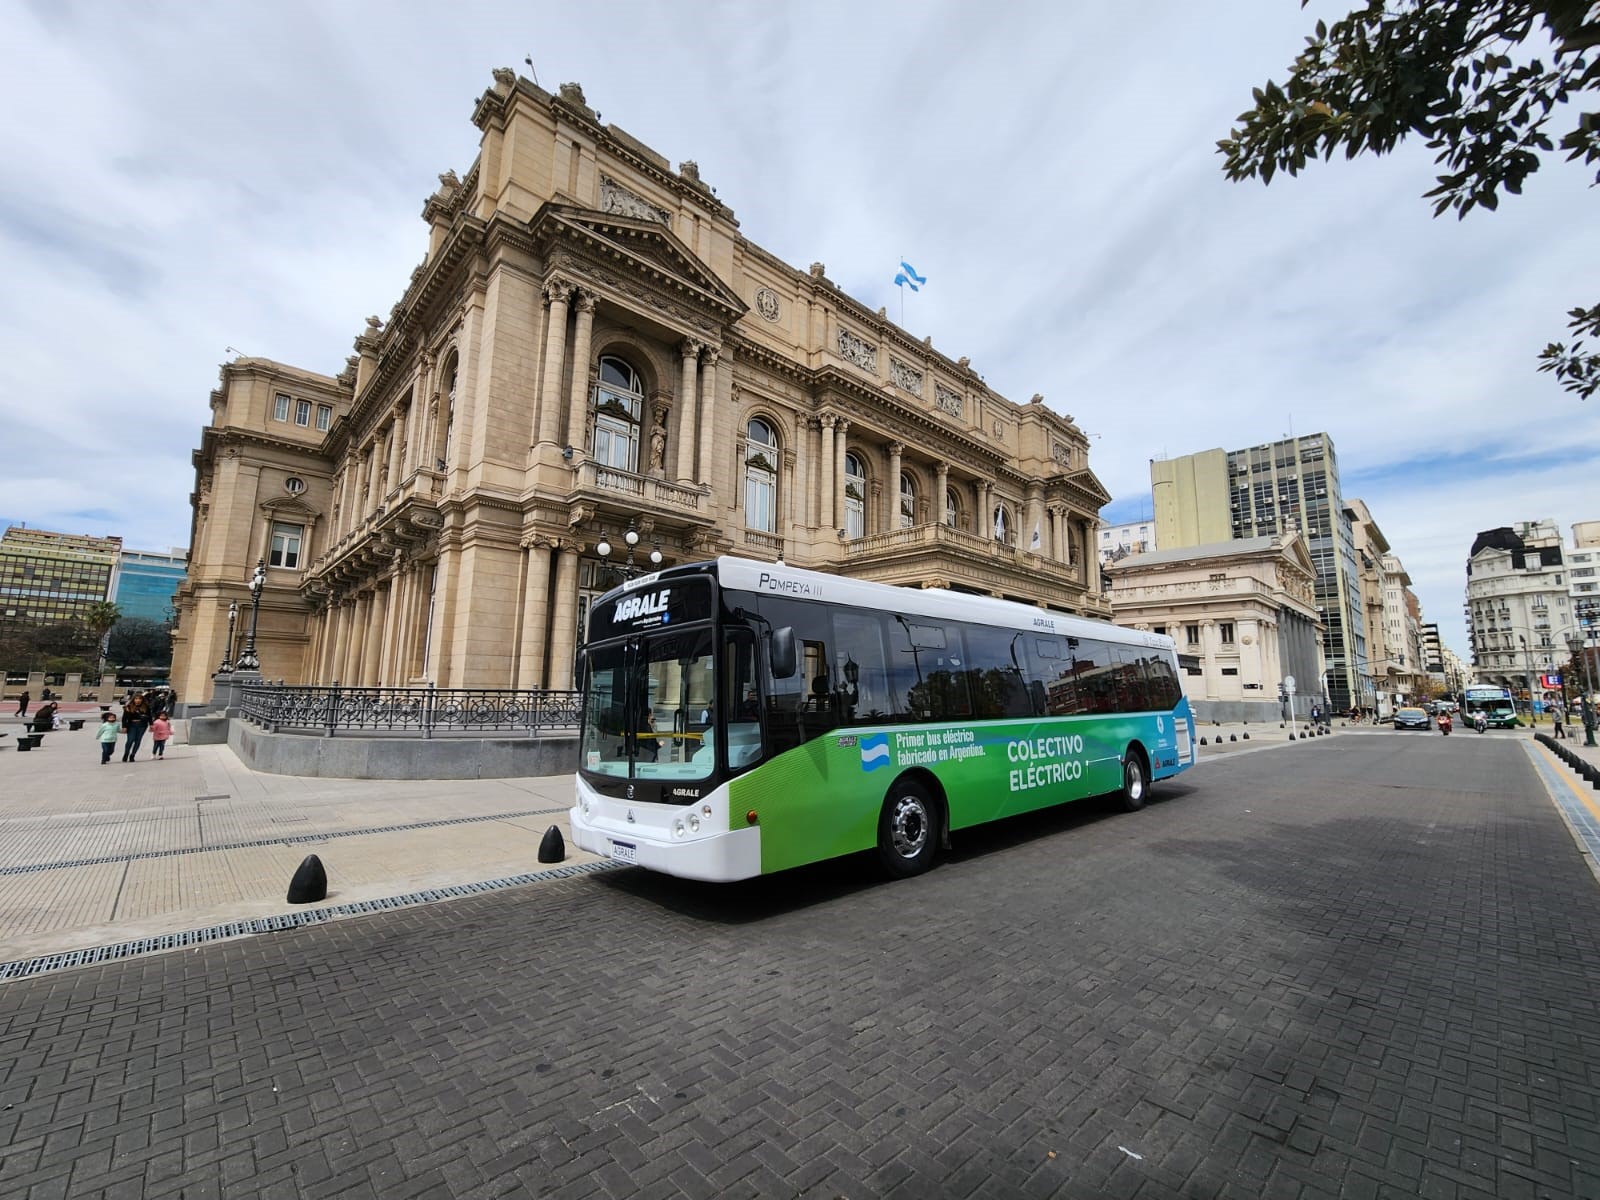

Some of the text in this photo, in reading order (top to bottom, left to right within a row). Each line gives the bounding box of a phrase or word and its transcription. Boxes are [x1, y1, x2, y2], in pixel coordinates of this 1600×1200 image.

[759, 573, 810, 594] POMPEYA
[613, 589, 671, 623] AGRALE
[1033, 618, 1055, 629] AGRALE
[896, 729, 975, 748] Primer bus eléctrico
[1007, 734, 1083, 762] COLECTIVO
[897, 743, 986, 766] fabricado en Argentina.
[1009, 760, 1082, 792] ELÉCTRICO
[672, 788, 700, 797] AGRALE
[613, 845, 635, 860] AGRALE
